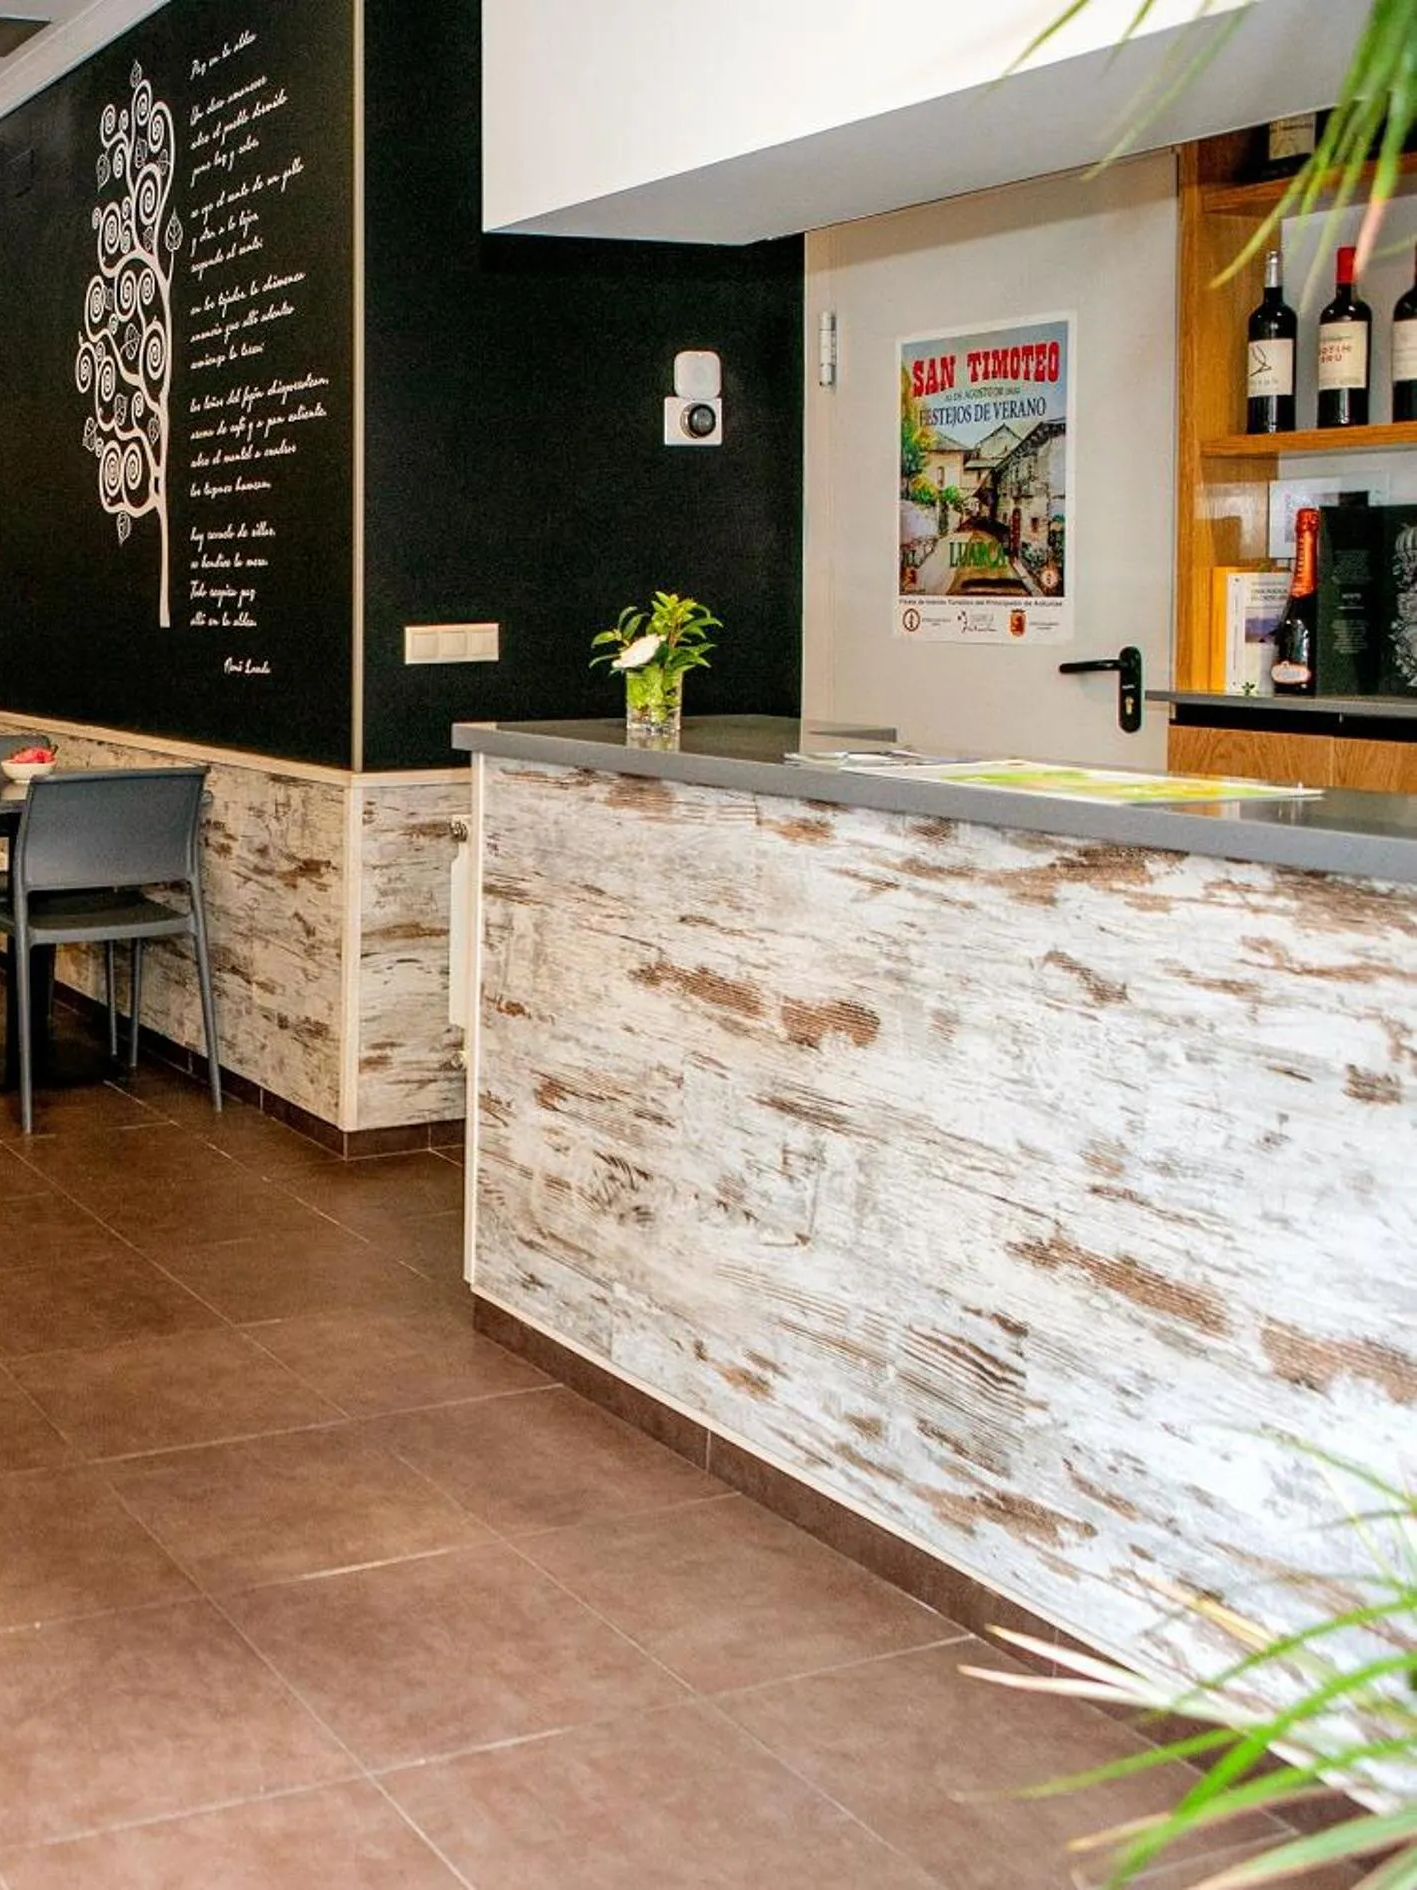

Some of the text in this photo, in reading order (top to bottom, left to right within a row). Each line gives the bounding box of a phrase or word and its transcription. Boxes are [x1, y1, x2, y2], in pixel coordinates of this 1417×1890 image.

[912, 341, 1060, 397] SAN TIMOTEO
[919, 397, 1047, 428] FESTEJOS DE VERANO
